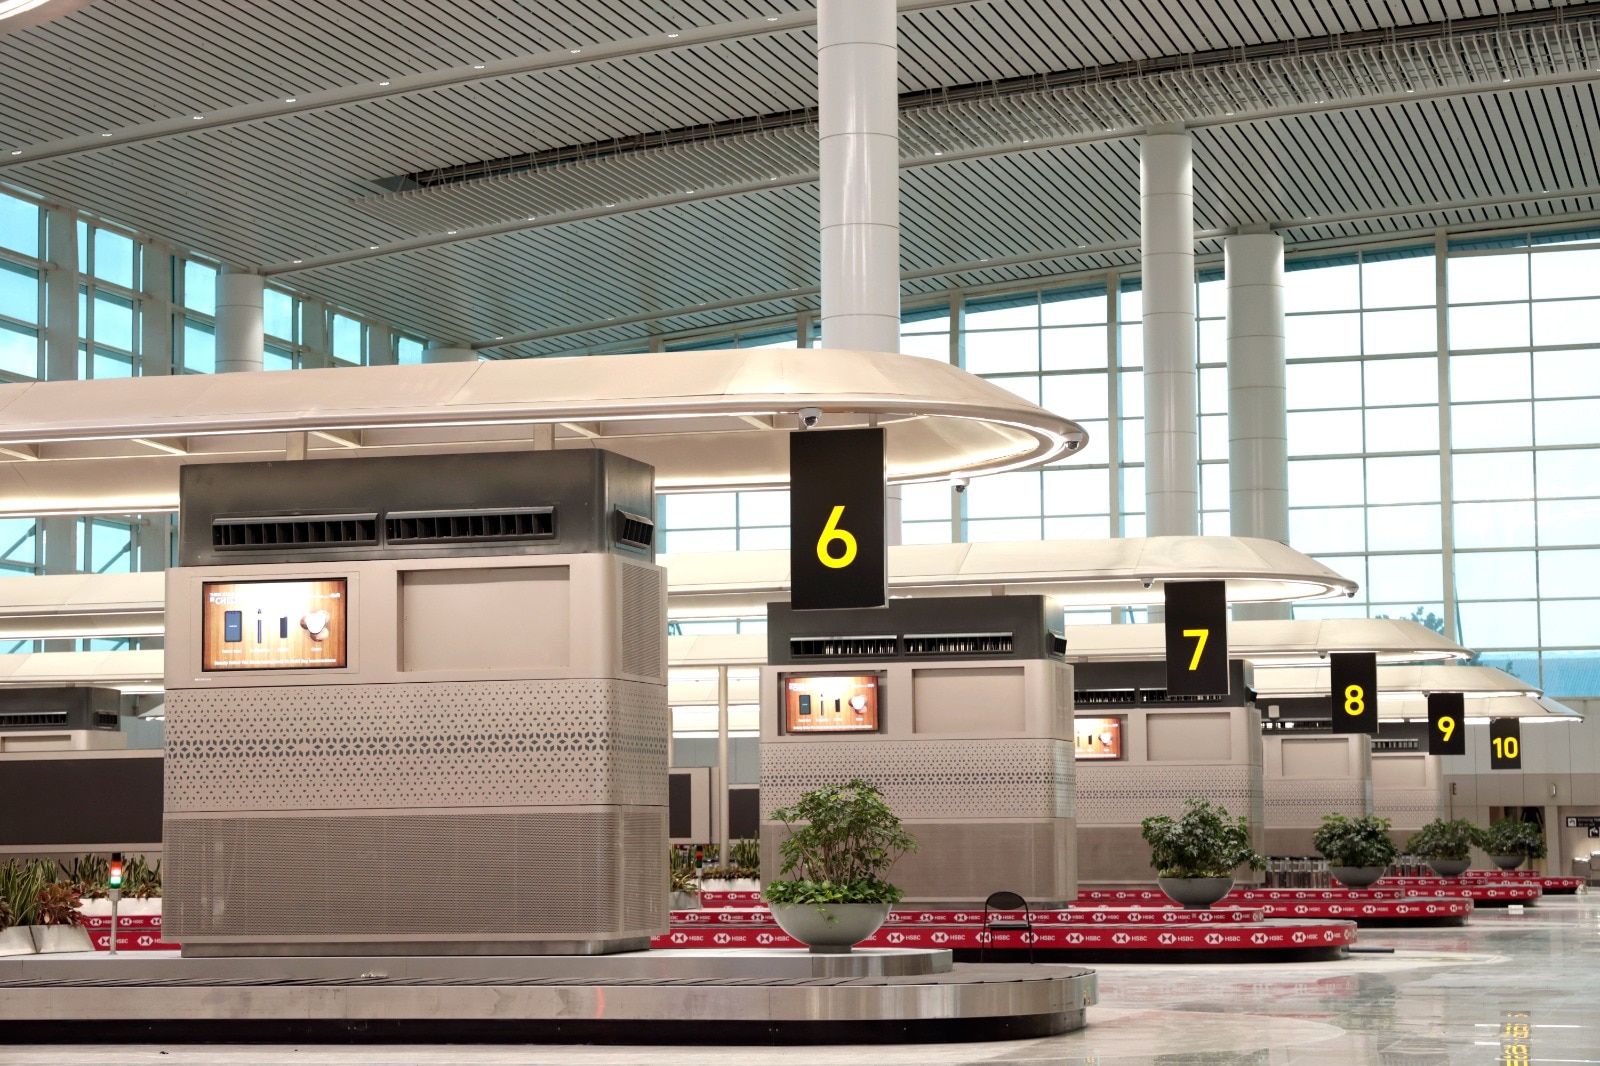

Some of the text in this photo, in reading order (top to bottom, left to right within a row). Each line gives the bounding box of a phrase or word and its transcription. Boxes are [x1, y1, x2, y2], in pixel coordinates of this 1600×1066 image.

[816, 505, 858, 569] 6
[1182, 628, 1209, 671] 7
[1344, 684, 1365, 716] 8
[1437, 716, 1455, 742] 9
[1492, 736, 1519, 759] 10
